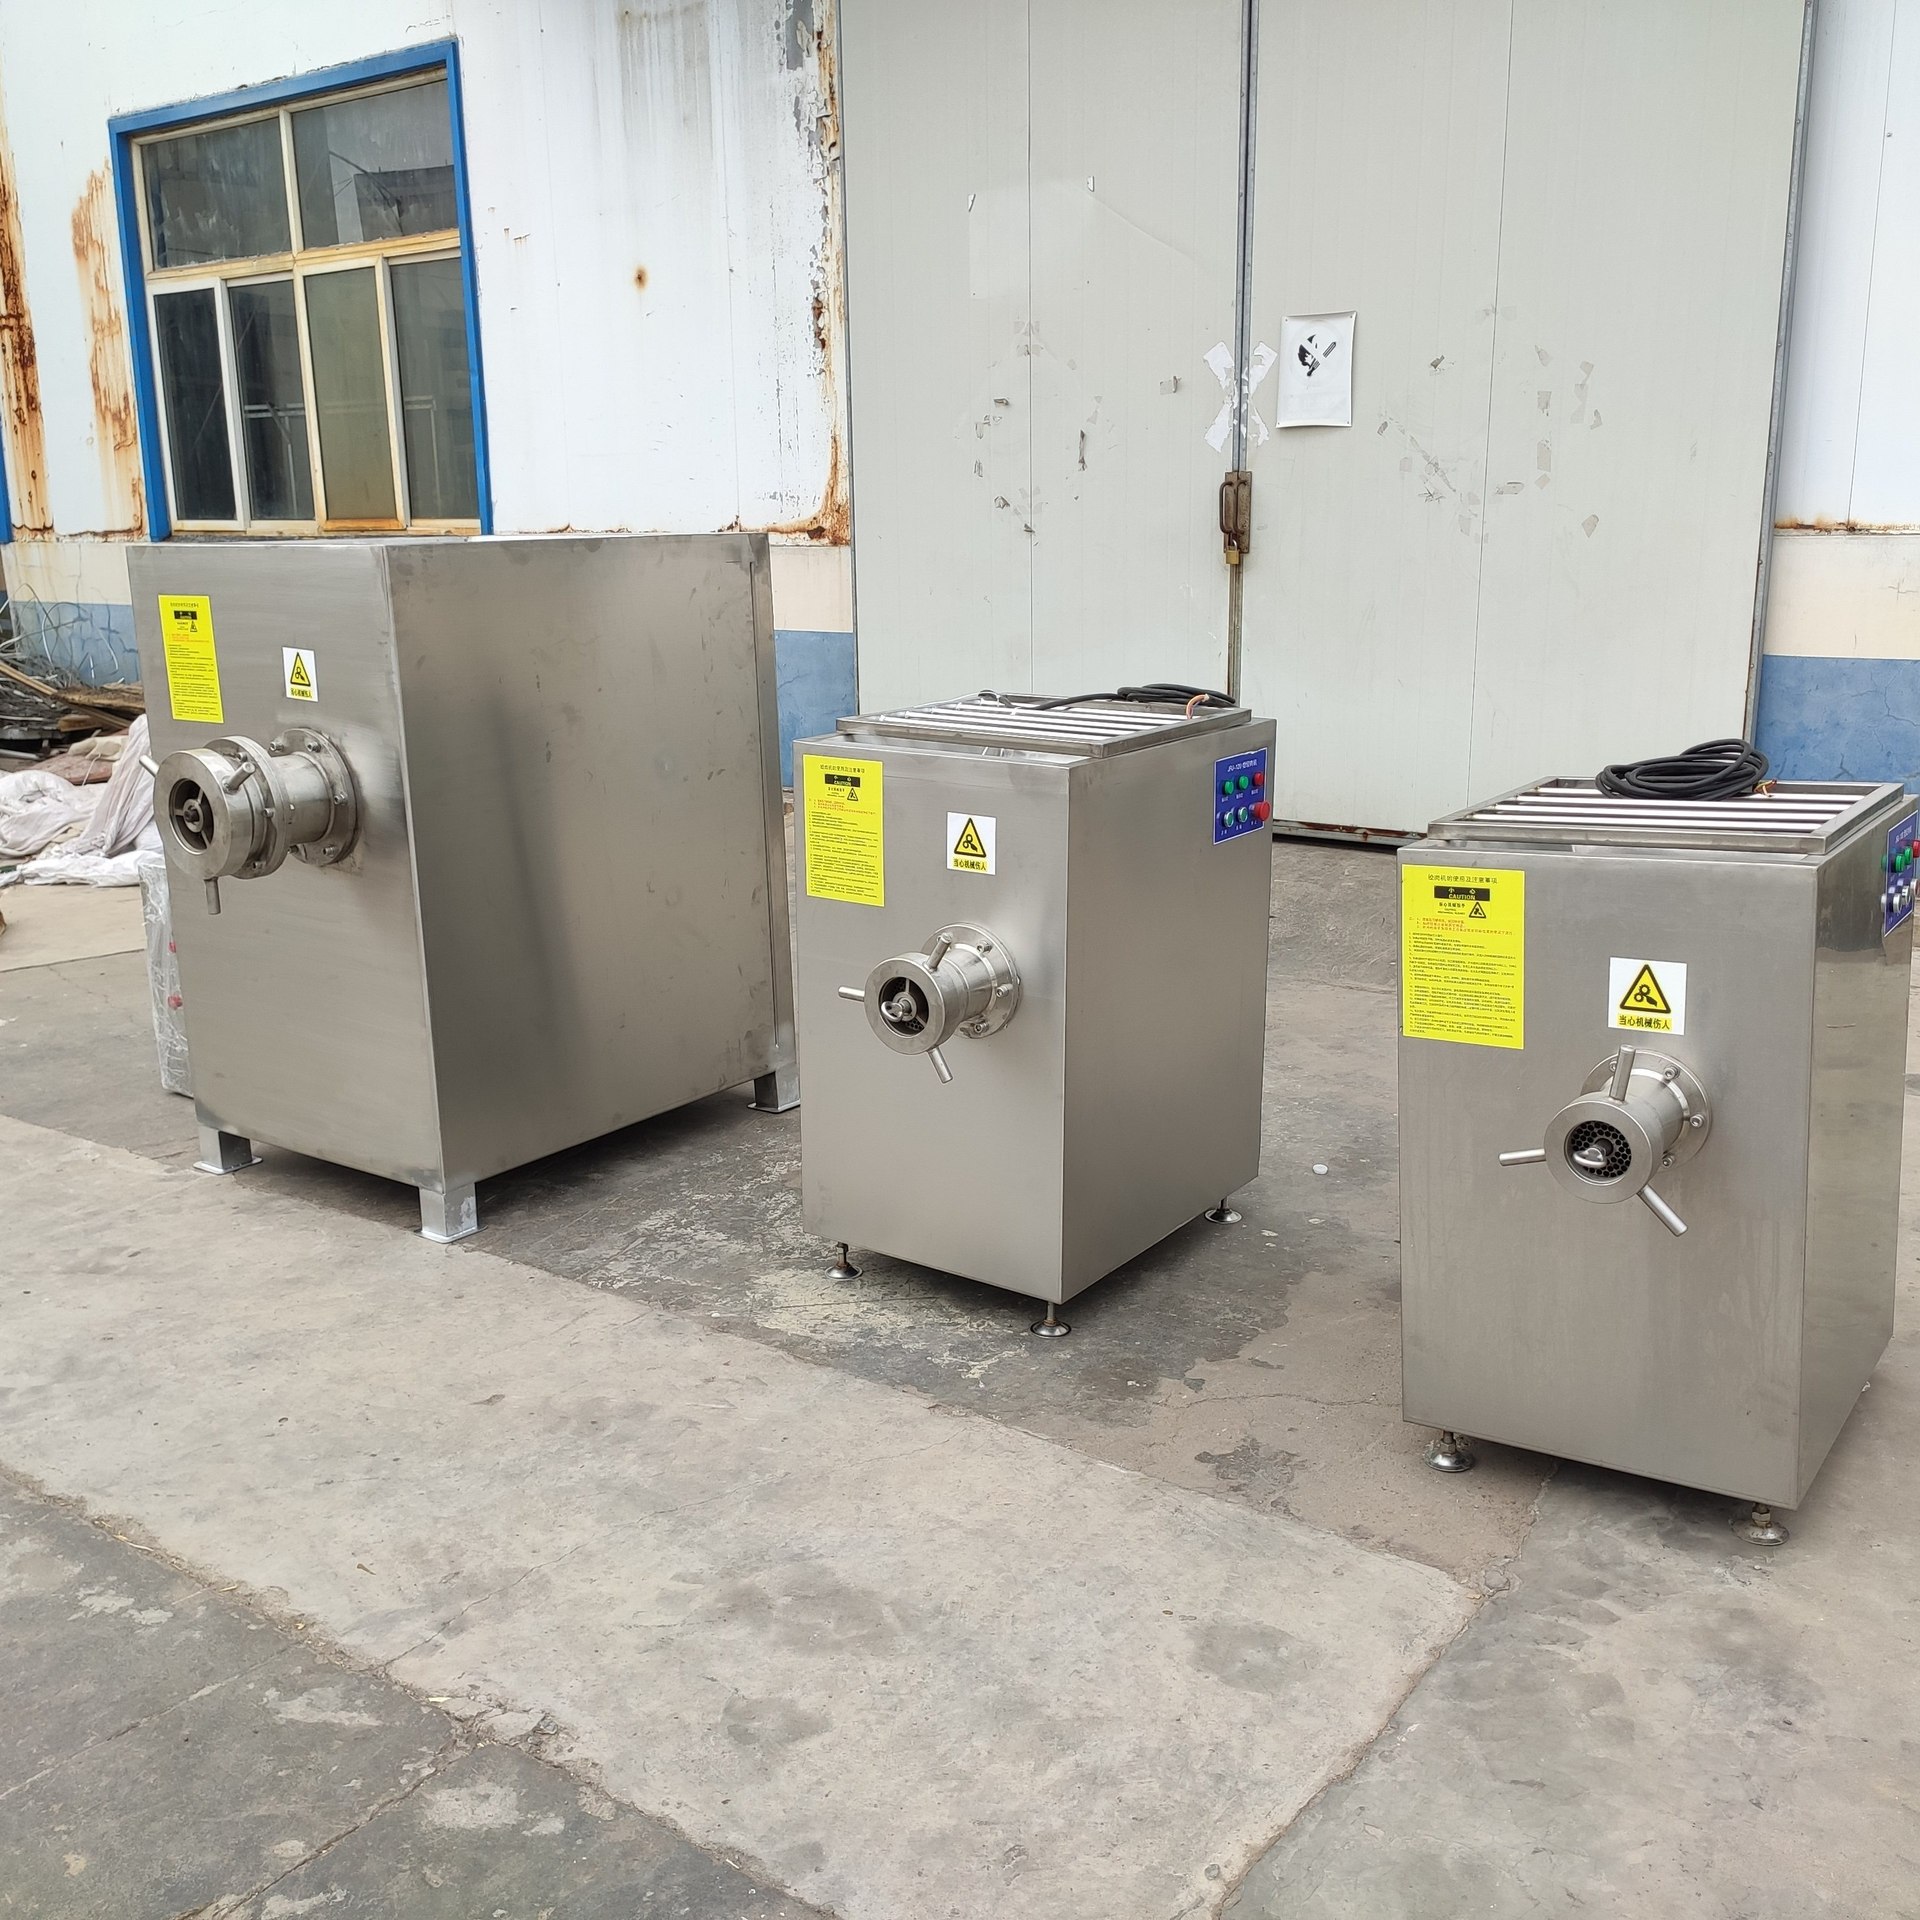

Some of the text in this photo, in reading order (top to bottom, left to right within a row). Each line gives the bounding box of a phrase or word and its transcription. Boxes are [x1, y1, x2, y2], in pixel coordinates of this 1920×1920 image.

[1619, 1015, 1670, 1030] 当心机械伤人
